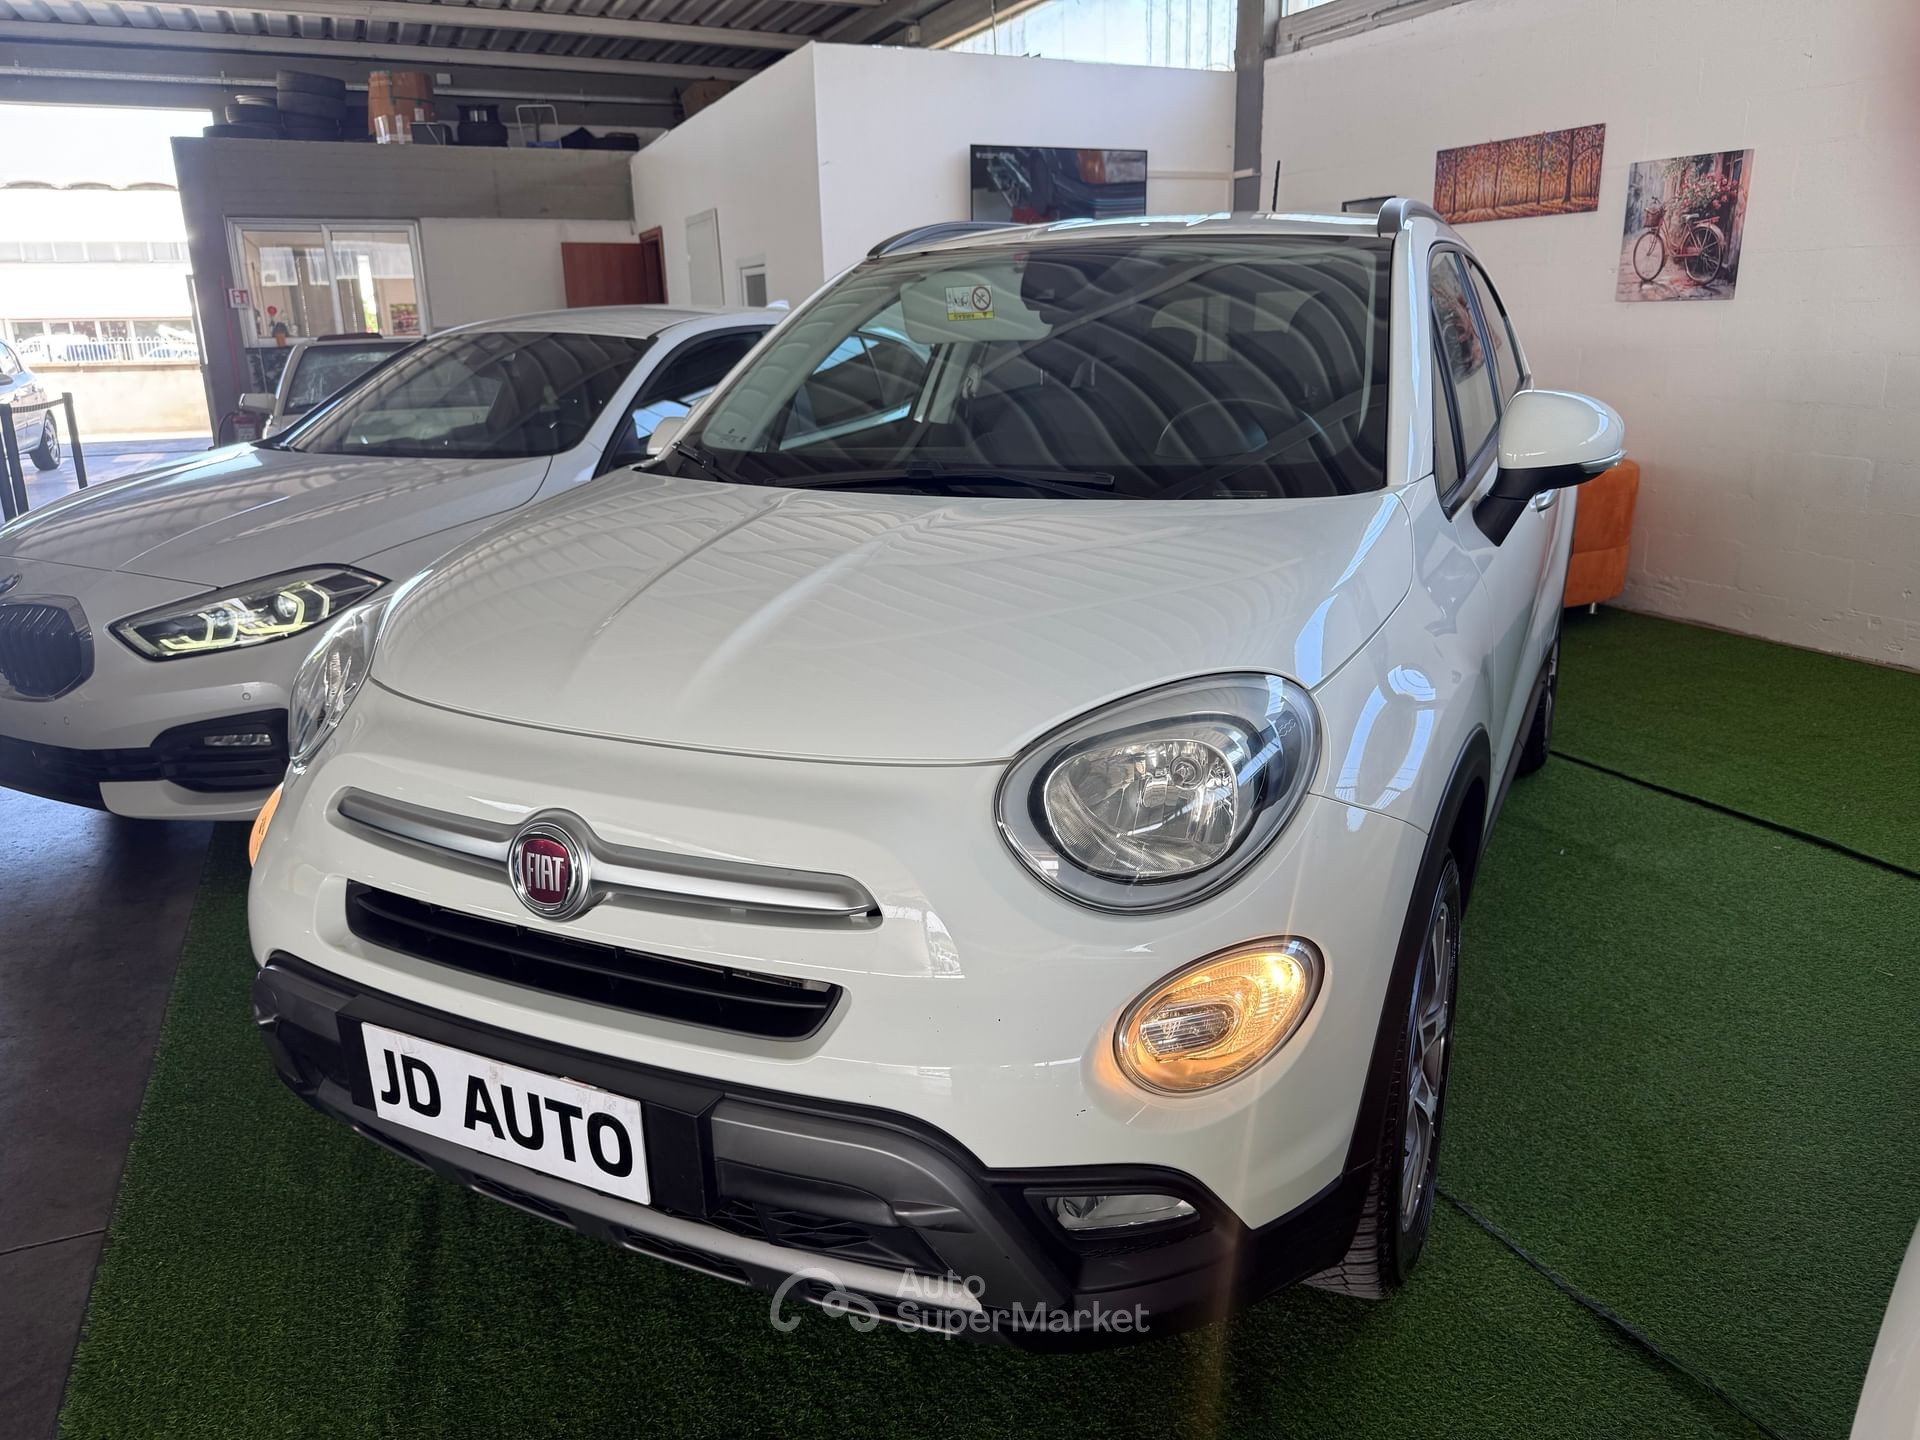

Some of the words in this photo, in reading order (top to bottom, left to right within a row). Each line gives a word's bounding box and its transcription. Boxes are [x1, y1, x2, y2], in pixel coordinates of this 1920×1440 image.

[526, 851, 565, 892] FIAT
[380, 1048, 441, 1118] JD
[464, 1074, 633, 1178] AUTO
